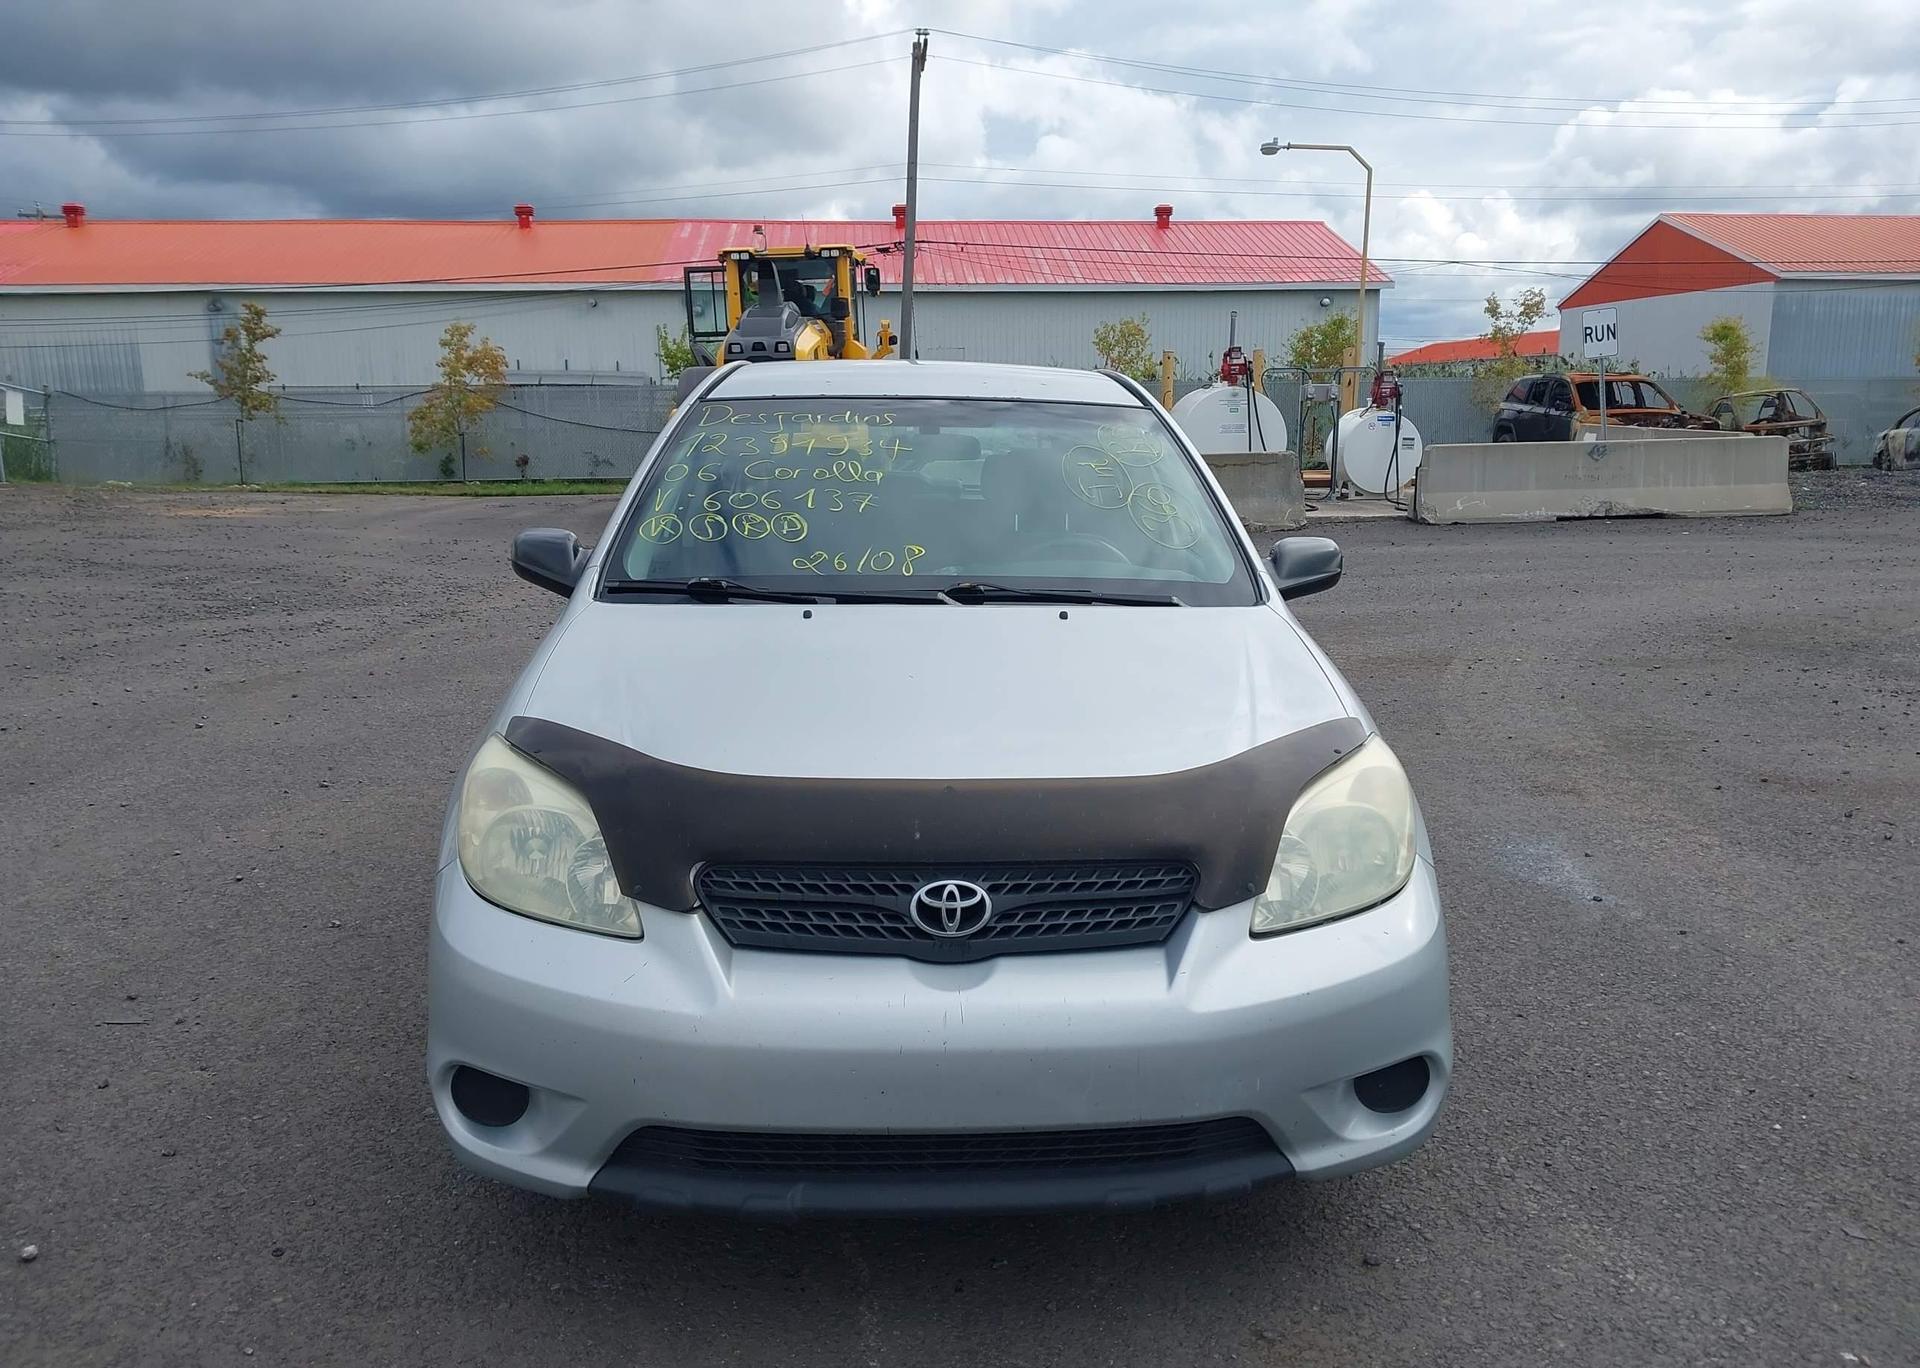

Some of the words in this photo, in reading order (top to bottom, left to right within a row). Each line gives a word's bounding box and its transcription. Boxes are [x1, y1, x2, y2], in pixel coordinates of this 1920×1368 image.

[1584, 323, 1617, 344] RUN
[664, 463, 722, 482] 06
[744, 460, 883, 486] Corolla
[703, 489, 880, 513] 606137
[792, 545, 926, 576] 26/08
